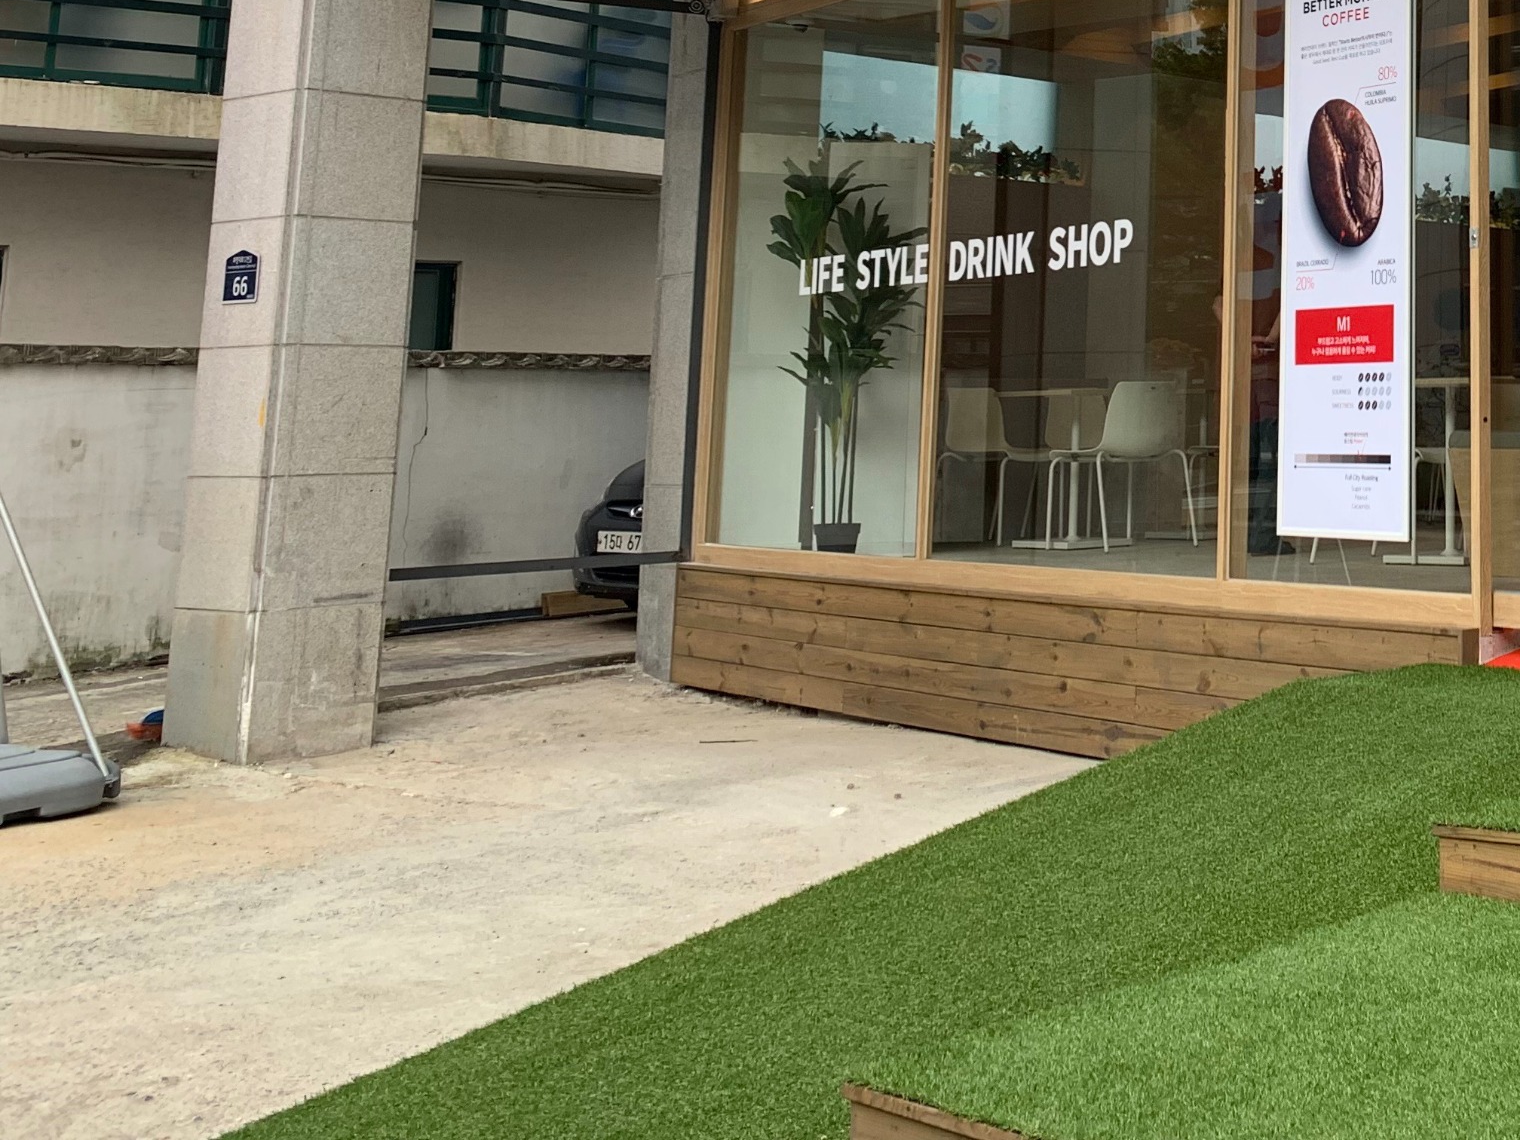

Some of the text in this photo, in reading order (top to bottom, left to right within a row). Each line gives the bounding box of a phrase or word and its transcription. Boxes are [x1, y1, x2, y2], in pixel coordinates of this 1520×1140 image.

[1322, 7, 1370, 27] COFFEE
[1378, 66, 1397, 80] 80%
[799, 218, 1134, 296] LIFE STYLE DRINK SHOP
[1296, 276, 1314, 290] 20%
[1371, 269, 1396, 285] 100%
[233, 276, 248, 296] 66
[1336, 316, 1350, 332] M1
